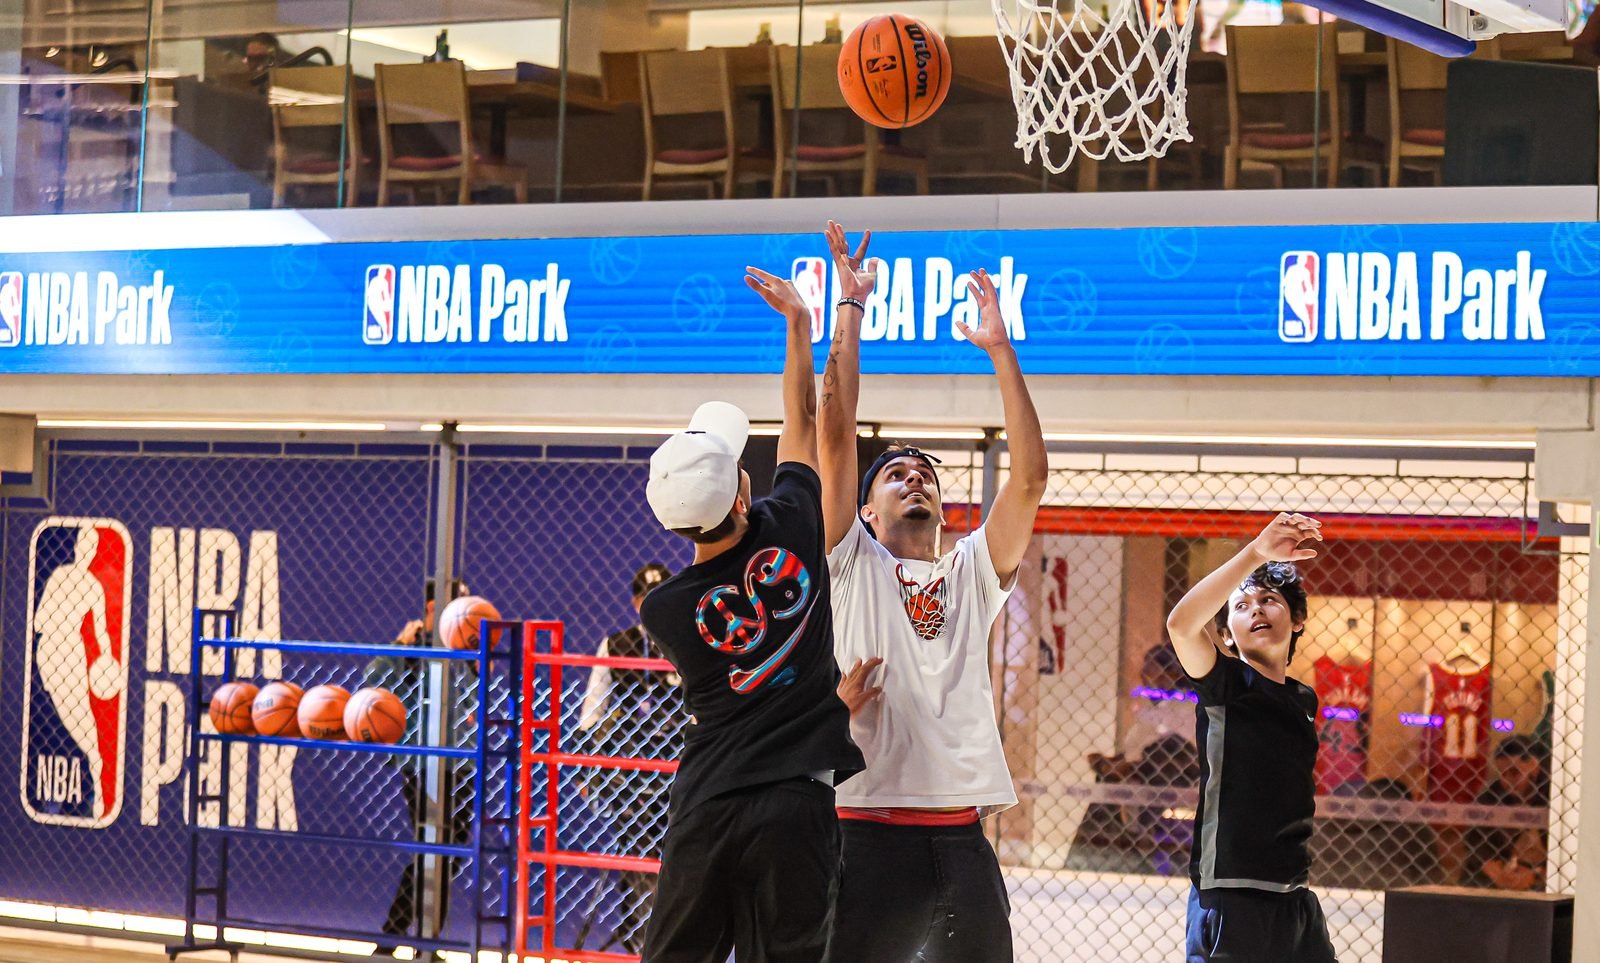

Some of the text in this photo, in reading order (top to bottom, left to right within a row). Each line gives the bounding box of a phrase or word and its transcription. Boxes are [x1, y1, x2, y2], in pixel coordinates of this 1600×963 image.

[904, 22, 932, 99] Wilson
[25, 270, 175, 345] NBA Park
[398, 263, 571, 343] NBA Park
[923, 256, 1028, 341] Pak
[1324, 250, 1547, 340] NBA Park
[145, 527, 283, 680] NBA
[1444, 712, 1478, 759] 11
[36, 753, 83, 804] NBA
